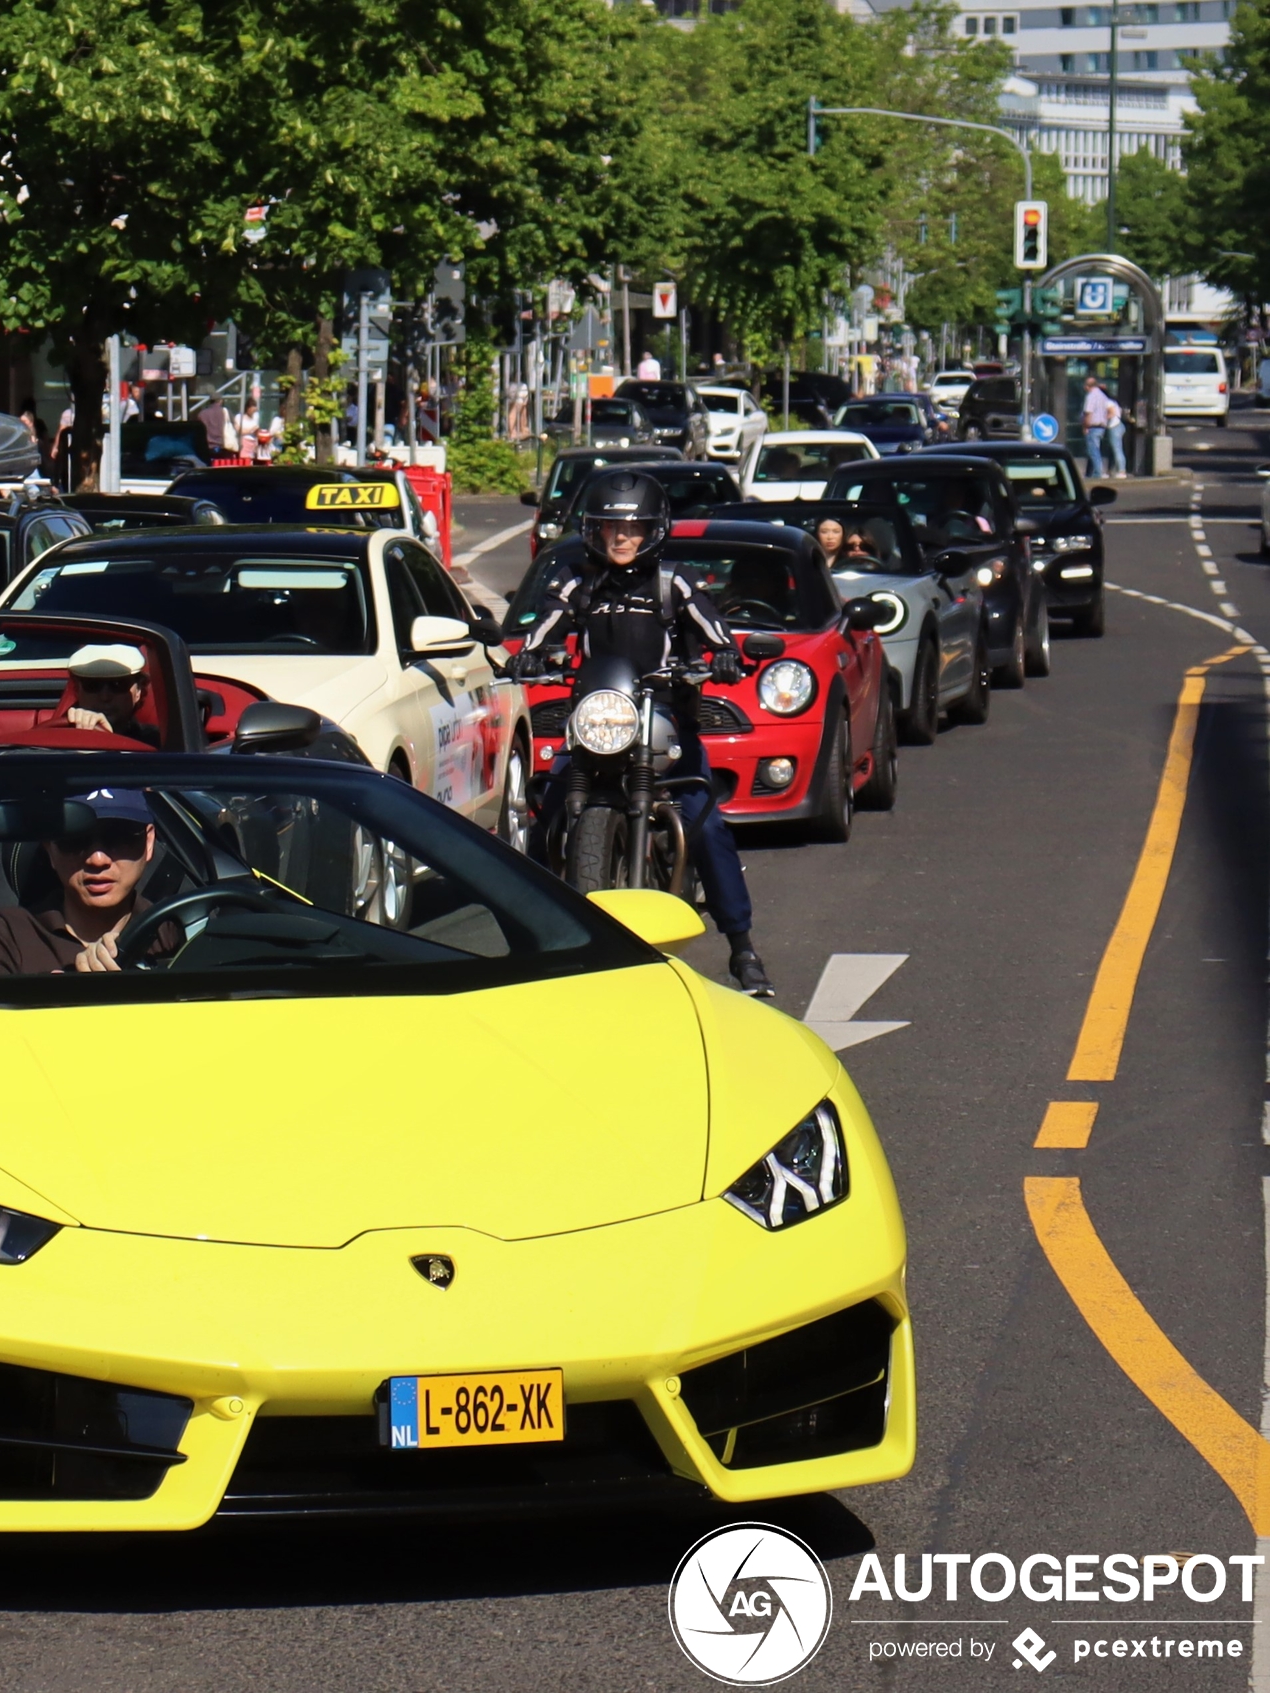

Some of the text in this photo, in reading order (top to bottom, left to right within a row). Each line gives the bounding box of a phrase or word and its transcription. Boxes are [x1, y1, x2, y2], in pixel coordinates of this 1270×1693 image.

[321, 487, 382, 505] TAXI
[391, 1382, 554, 1447] NL L-862-XK
